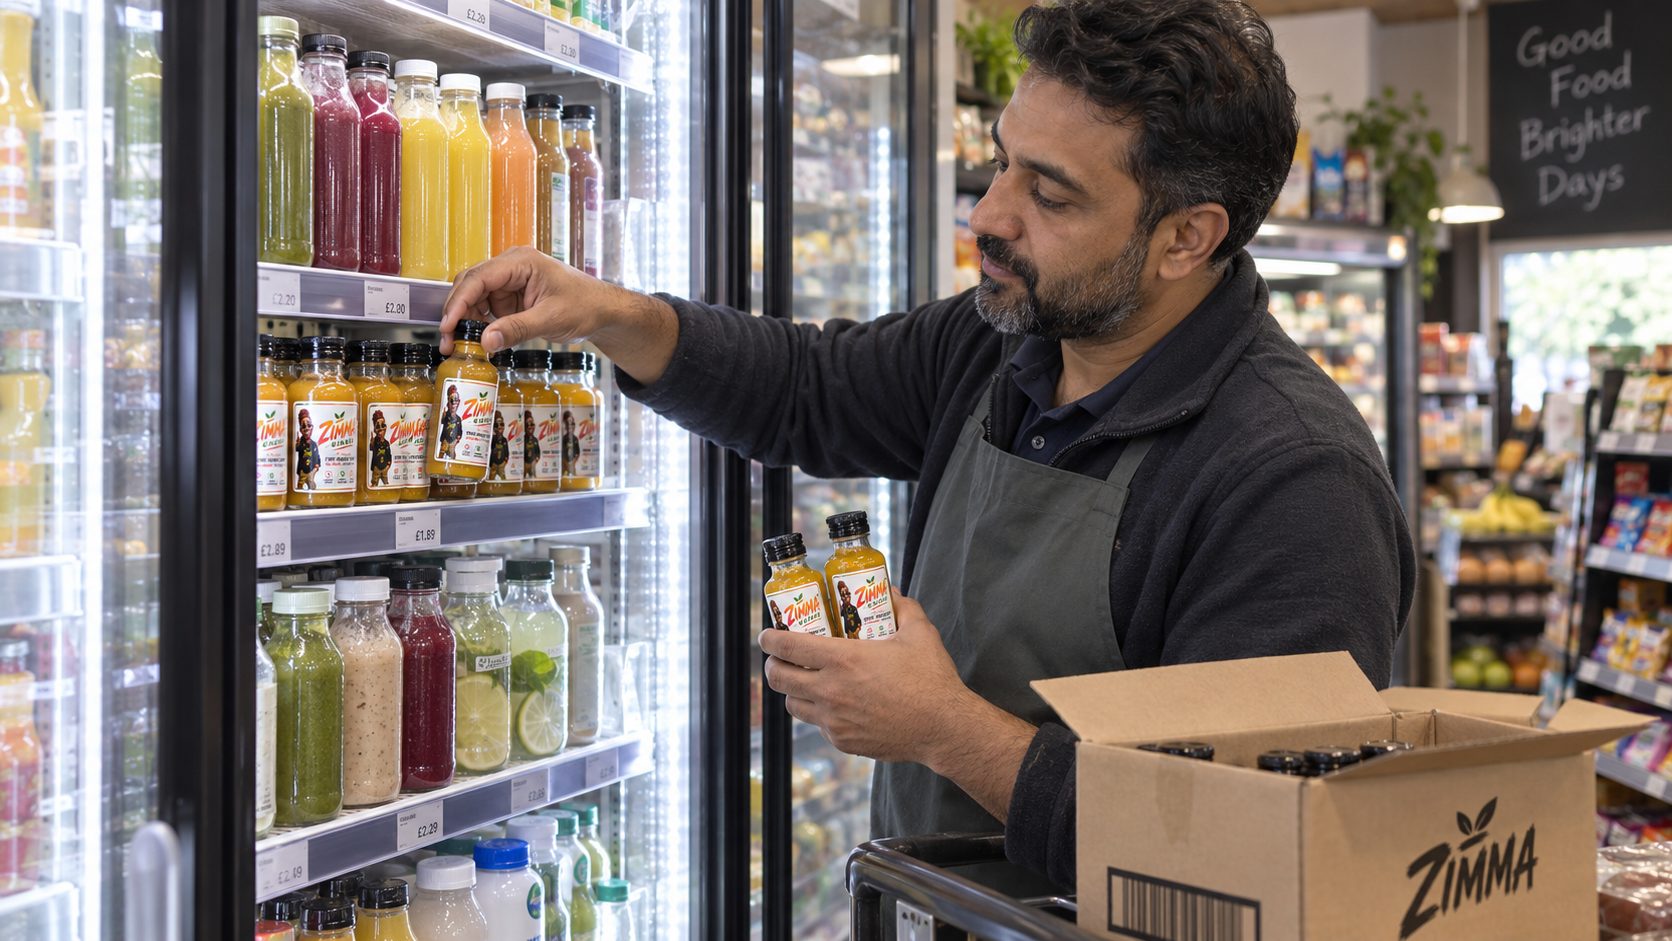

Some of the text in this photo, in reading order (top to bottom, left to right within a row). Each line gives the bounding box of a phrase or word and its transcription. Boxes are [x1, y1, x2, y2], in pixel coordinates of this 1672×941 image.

[1516, 9, 1613, 67] Good
[1551, 49, 1632, 109] Food
[1520, 102, 1651, 163] Brighter
[1539, 164, 1625, 212] Days
[784, 595, 820, 627] ZIMMA
[1399, 823, 1539, 940] ZIMMA
